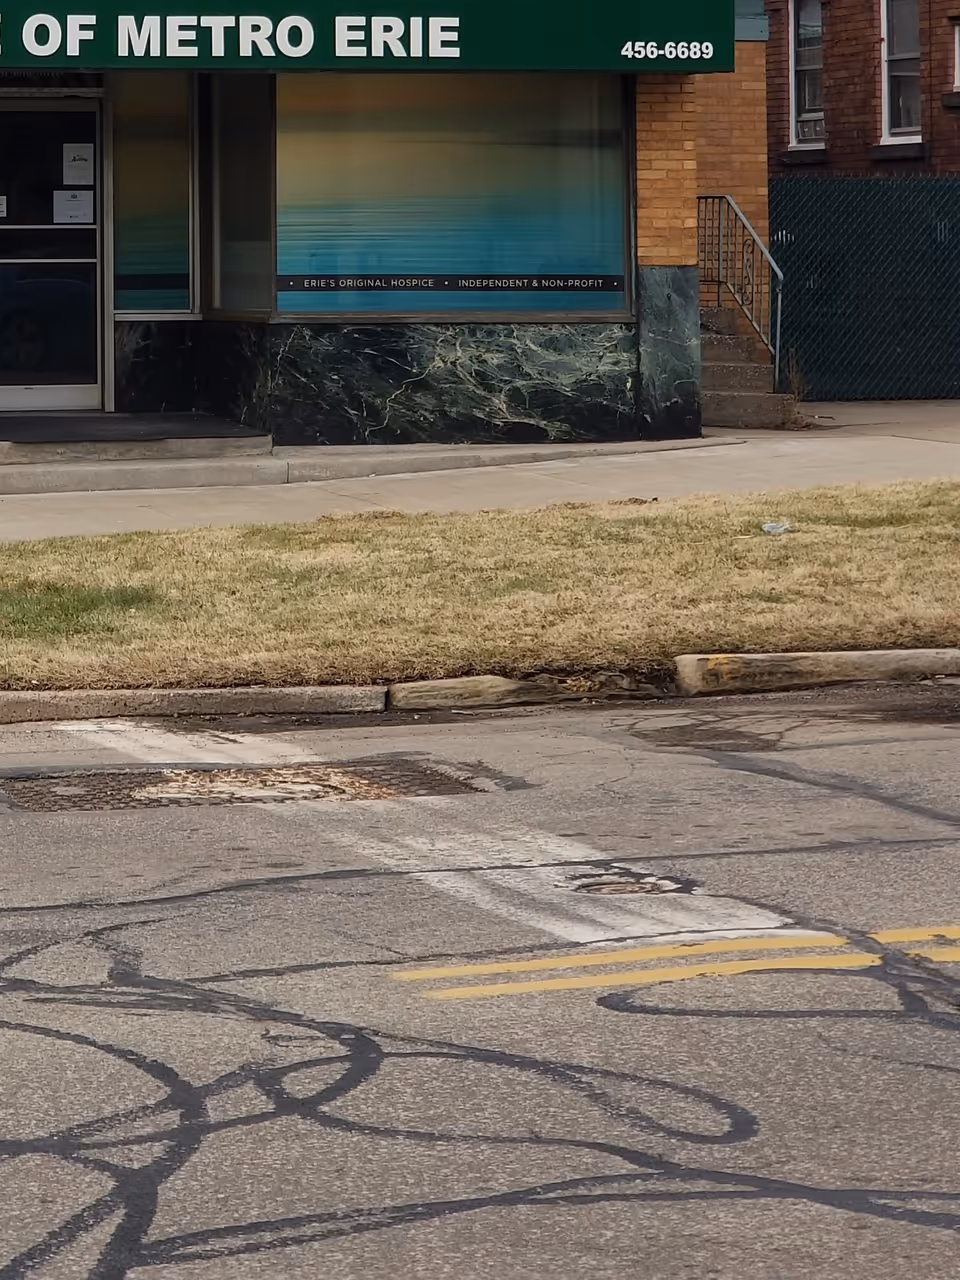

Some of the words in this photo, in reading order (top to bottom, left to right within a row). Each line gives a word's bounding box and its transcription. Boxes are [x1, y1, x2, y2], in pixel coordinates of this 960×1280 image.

[22, 13, 97, 57] OF
[117, 15, 315, 59] METRO
[334, 16, 461, 59] ERIE
[620, 41, 715, 60] 456-6689
[303, 279, 335, 288] ERIE'S
[339, 279, 387, 287] ORIGINAL
[390, 278, 434, 287] HOSPICE
[458, 279, 528, 287] INDEPENDENT
[531, 279, 539, 287] &
[541, 279, 604, 288] NON-PROFIT
